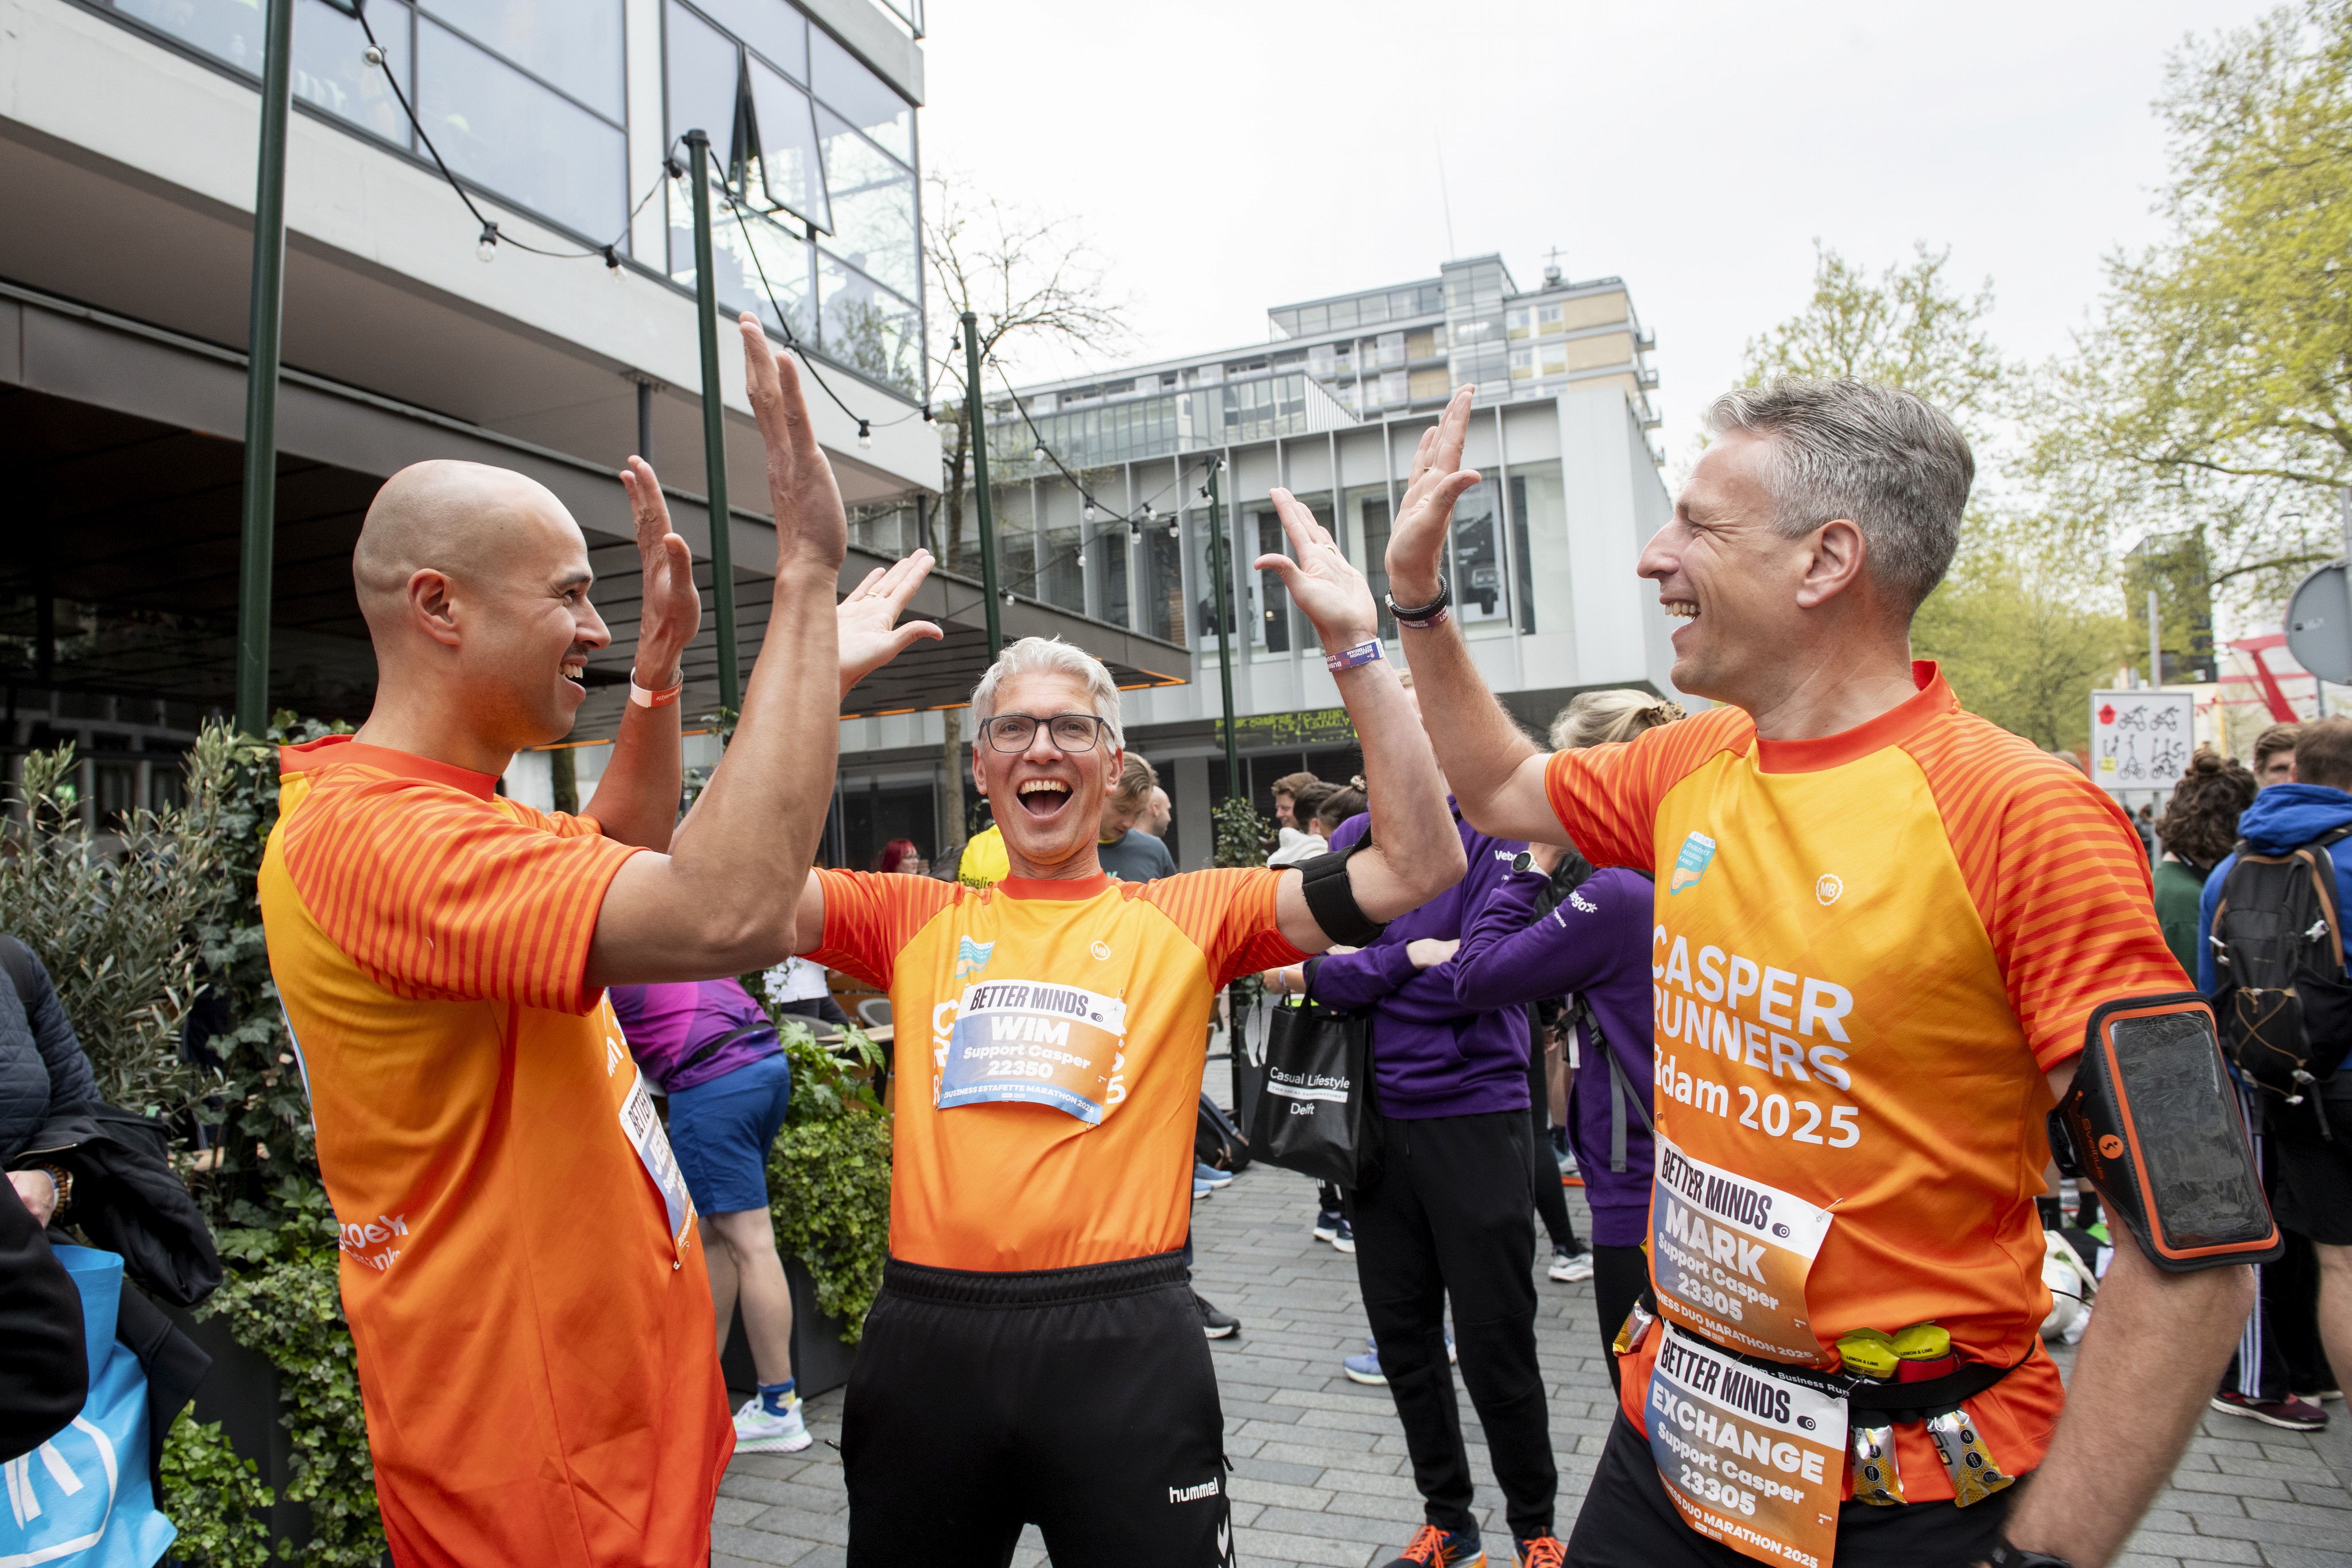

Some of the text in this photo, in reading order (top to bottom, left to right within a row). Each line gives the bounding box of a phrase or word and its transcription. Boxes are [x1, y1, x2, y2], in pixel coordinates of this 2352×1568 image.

[1349, 648, 1373, 659] MARATHON
[1820, 882, 1835, 897] MB
[1095, 946, 1107, 957] MB
[1653, 924, 1853, 1043] CASPER
[969, 985, 1089, 1017] BETTER MINDS
[991, 1016, 1070, 1047] WIM
[963, 1044, 1025, 1059] Support
[1028, 1044, 1091, 1070] Casper
[987, 1060, 1053, 1078] 22350
[1270, 1067, 1350, 1090] Casual Lifestyle
[944, 1086, 978, 1098] BUSINESS
[978, 1084, 1025, 1093] ESTAFETTE
[1026, 1085, 1077, 1105] MARATHON
[1290, 1102, 1315, 1115] Delft
[1739, 1086, 1860, 1148] 2025
[1662, 1147, 1773, 1230] BETTER MINDS
[1665, 1197, 1767, 1286] MARK
[1658, 1232, 1779, 1310] Support Casper
[1678, 1272, 1743, 1321] 23305
[1681, 1306, 1704, 1324] DUO
[1705, 1318, 1776, 1353] MARATHON
[1777, 1347, 1814, 1359] 2025
[1846, 1355, 1862, 1364] LEMON
[1848, 1364, 1876, 1375] ISOTONIC
[1661, 1337, 1790, 1424] BETTER MINDS
[1778, 1372, 1824, 1389] Business
[1827, 1383, 1850, 1396] Run
[1652, 1380, 1825, 1485] EXCHANGE
[1658, 1422, 1805, 1504] Support Casper
[1169, 1477, 1219, 1504] hummel
[1680, 1464, 1756, 1515] 23305
[1819, 1513, 1832, 1521] WAVE
[1682, 1498, 1702, 1519] DUO
[1704, 1512, 1782, 1554] MARATHON
[1783, 1546, 1819, 1568] 2025
